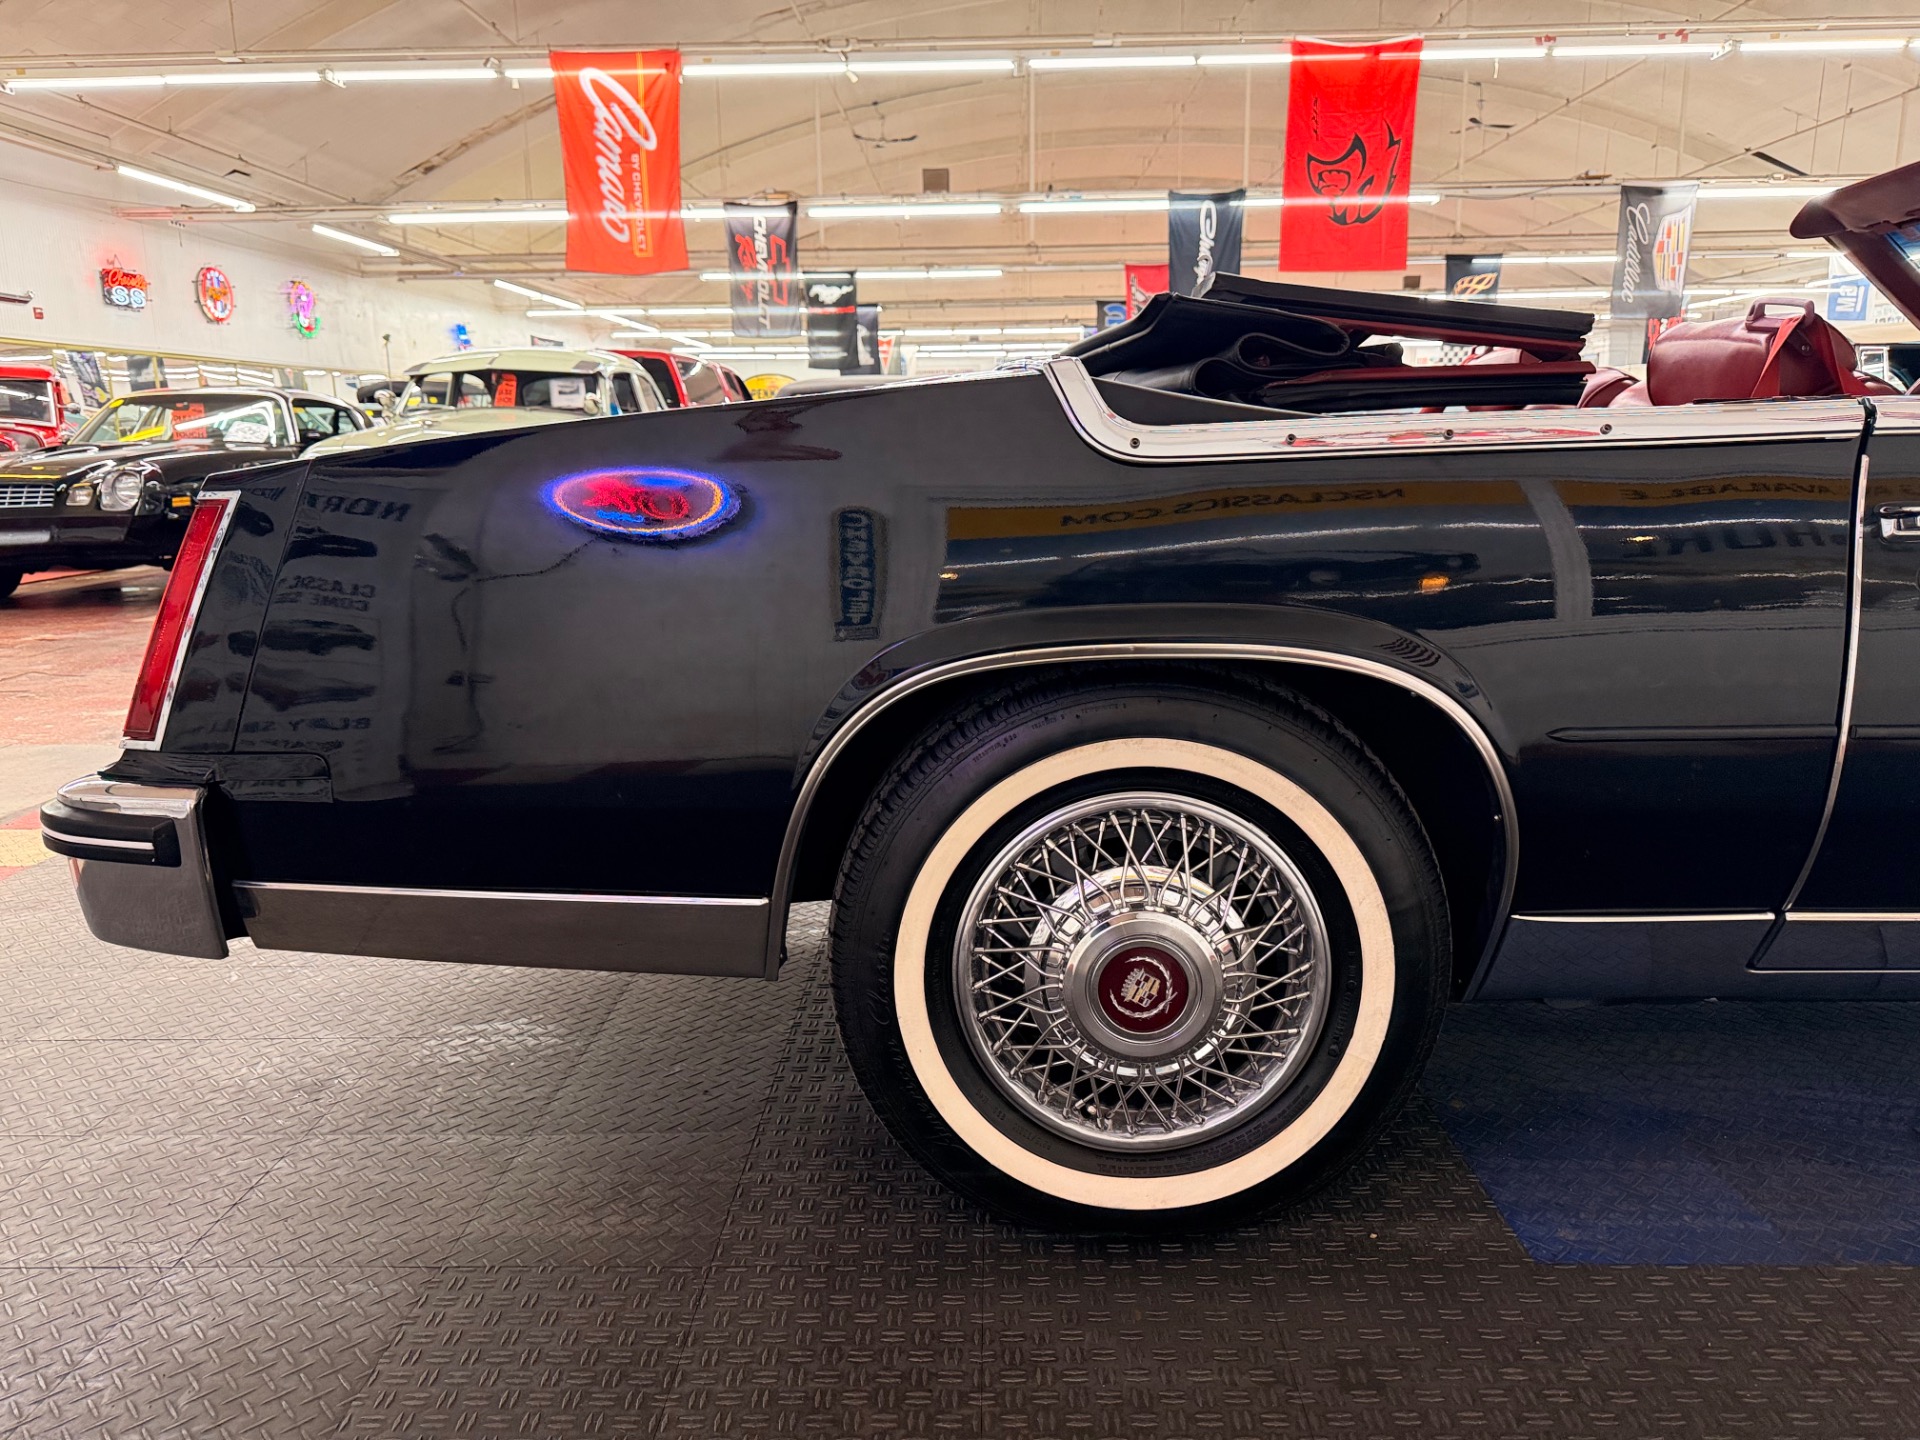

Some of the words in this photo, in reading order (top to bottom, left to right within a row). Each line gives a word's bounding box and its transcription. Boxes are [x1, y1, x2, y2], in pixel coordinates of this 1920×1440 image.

[578, 67, 657, 243] Camaro
[631, 153, 640, 171] BY
[632, 171, 646, 250] CHEVROLET
[1621, 202, 1650, 303] Cadillac
[111, 285, 147, 308] SS
[1835, 285, 1858, 312] GM
[866, 931, 892, 1026] Classic
